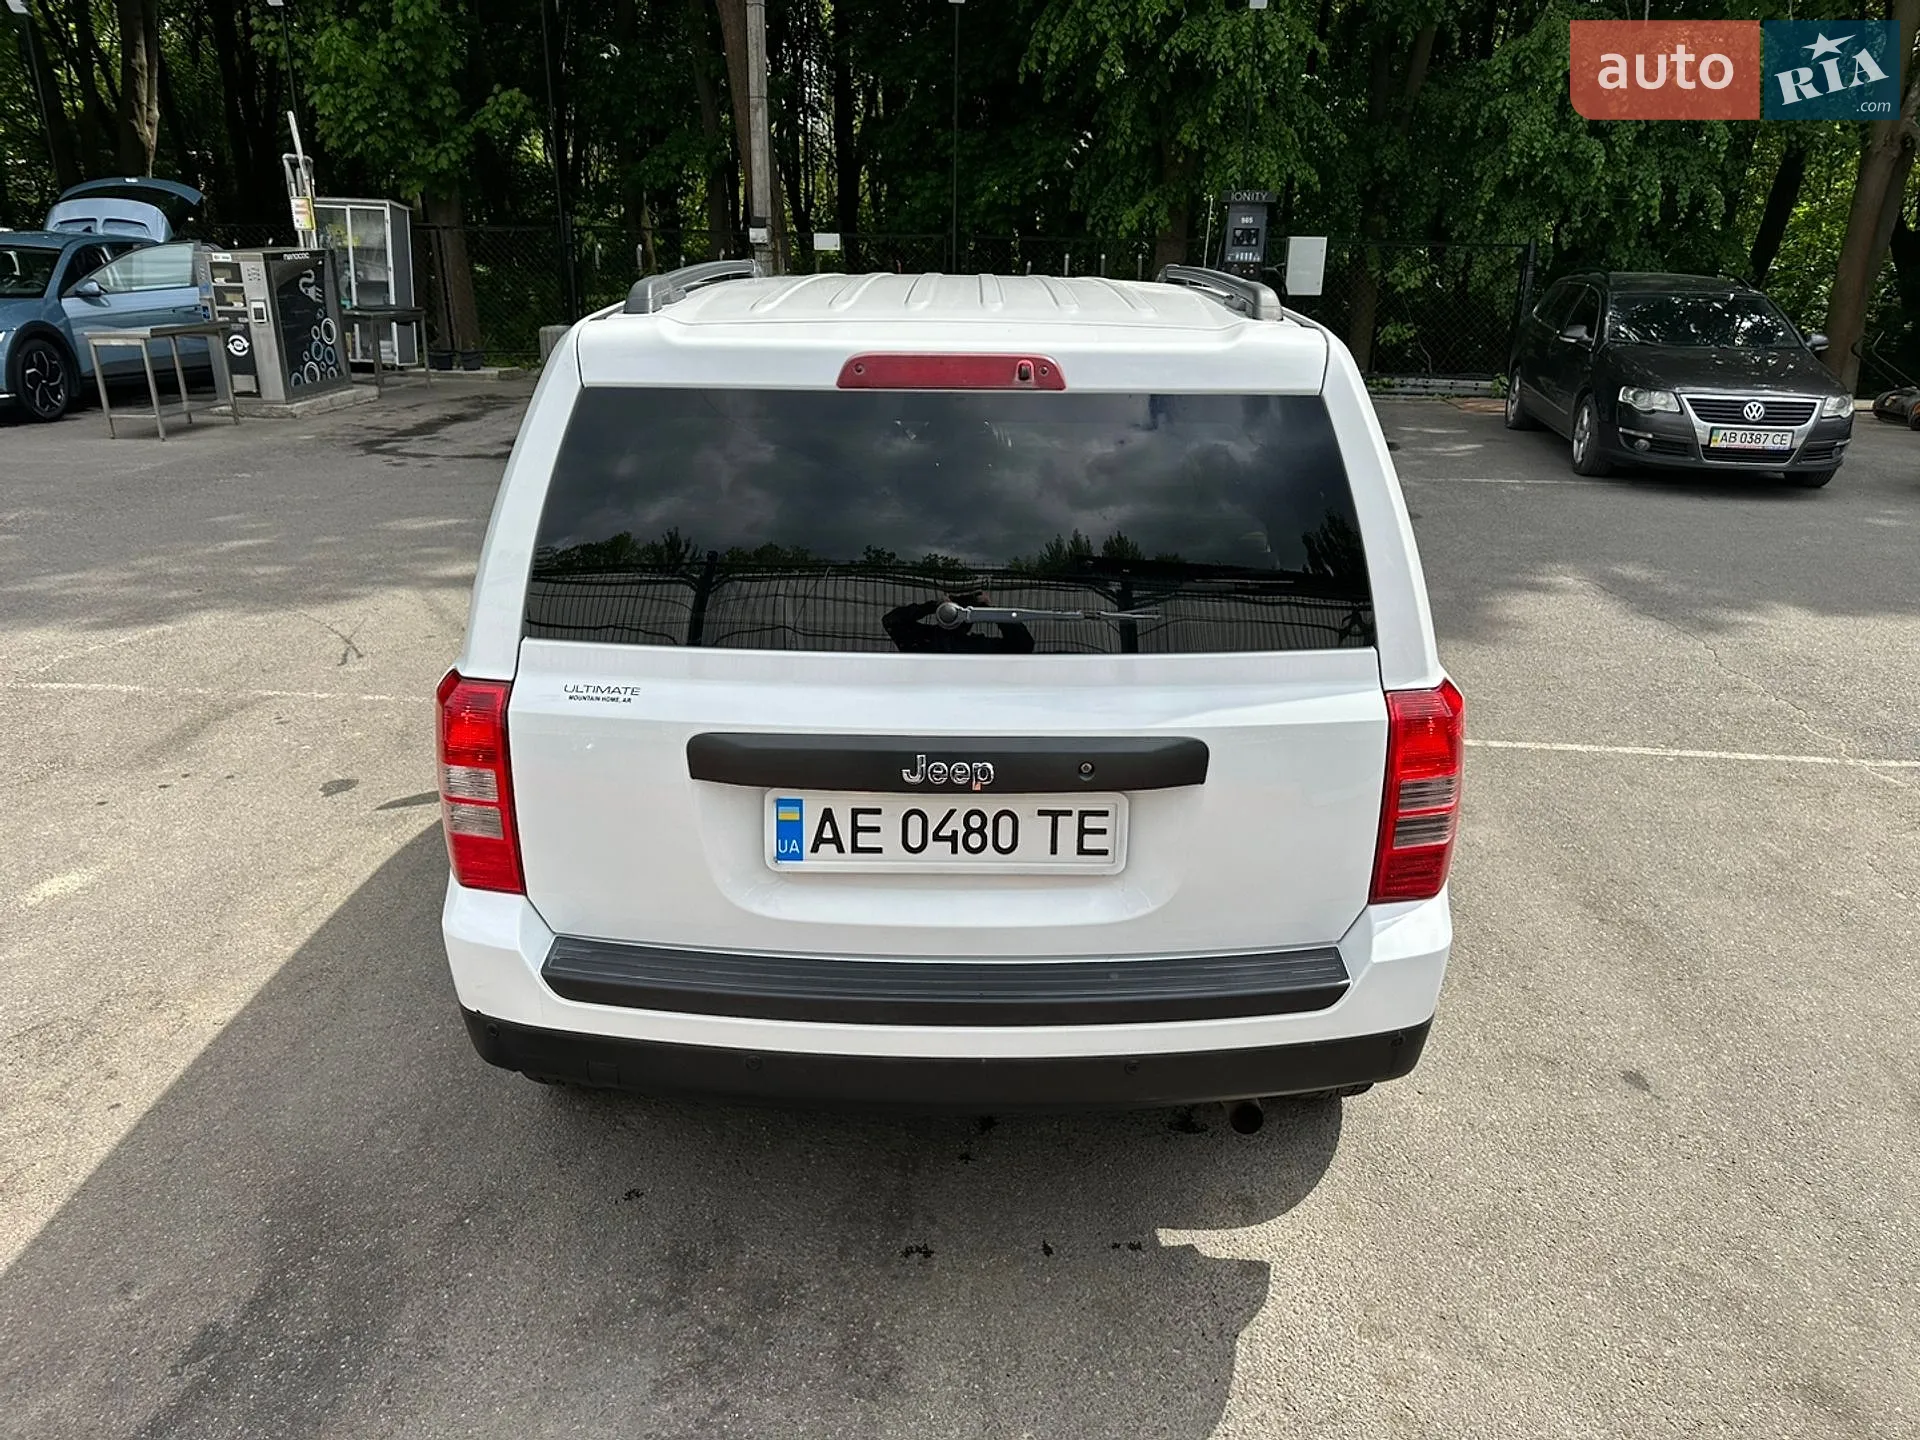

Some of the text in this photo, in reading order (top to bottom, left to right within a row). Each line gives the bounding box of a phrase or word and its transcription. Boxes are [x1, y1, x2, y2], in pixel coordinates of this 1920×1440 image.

[1231, 192, 1267, 201] IONITY
[1720, 432, 1789, 445] AB 0387 CE
[564, 684, 640, 695] ULTIMATE
[902, 754, 995, 790] Jeep
[810, 807, 1110, 857] AE 0480 TE
[777, 840, 800, 855] UA
